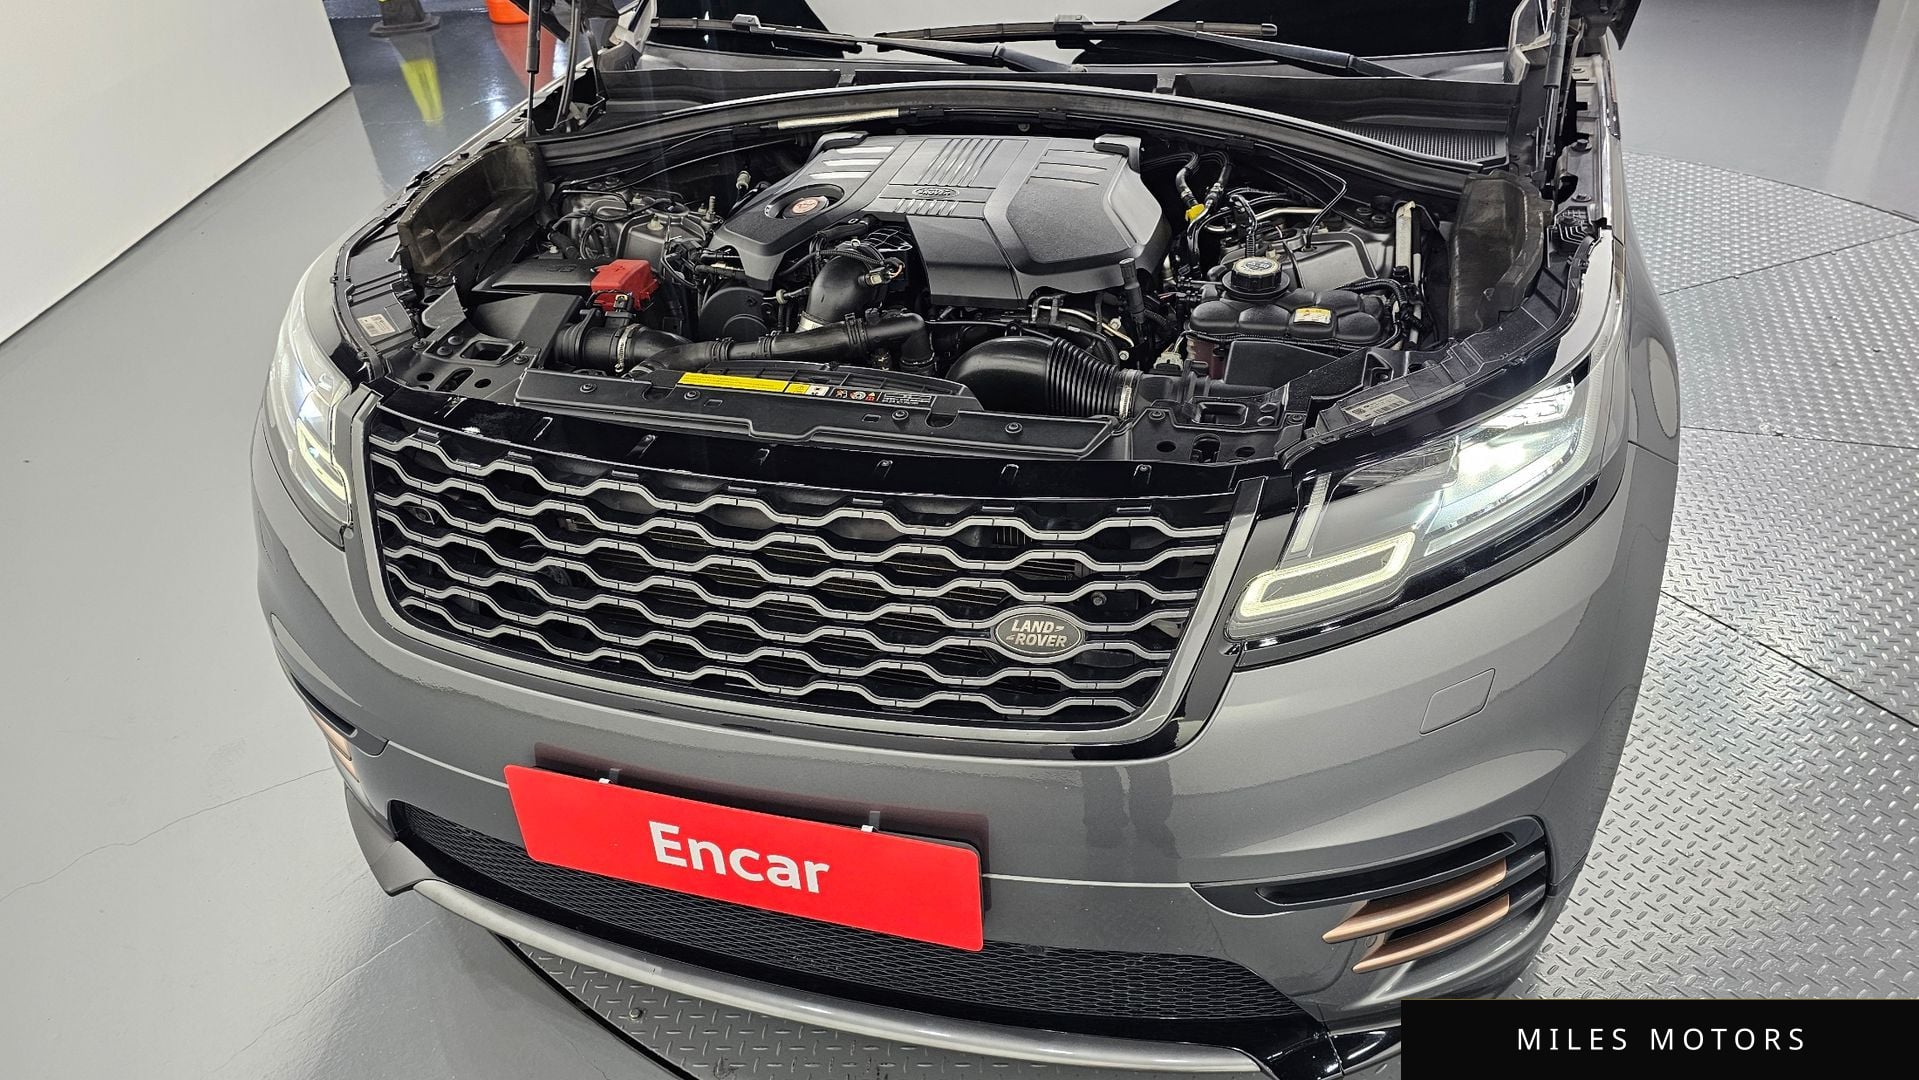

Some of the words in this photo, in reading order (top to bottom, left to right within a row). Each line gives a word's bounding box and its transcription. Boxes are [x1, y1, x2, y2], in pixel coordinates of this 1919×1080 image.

[1011, 619, 1055, 634] LAND
[1014, 633, 1068, 647] ROVER
[649, 821, 830, 894] Encar
